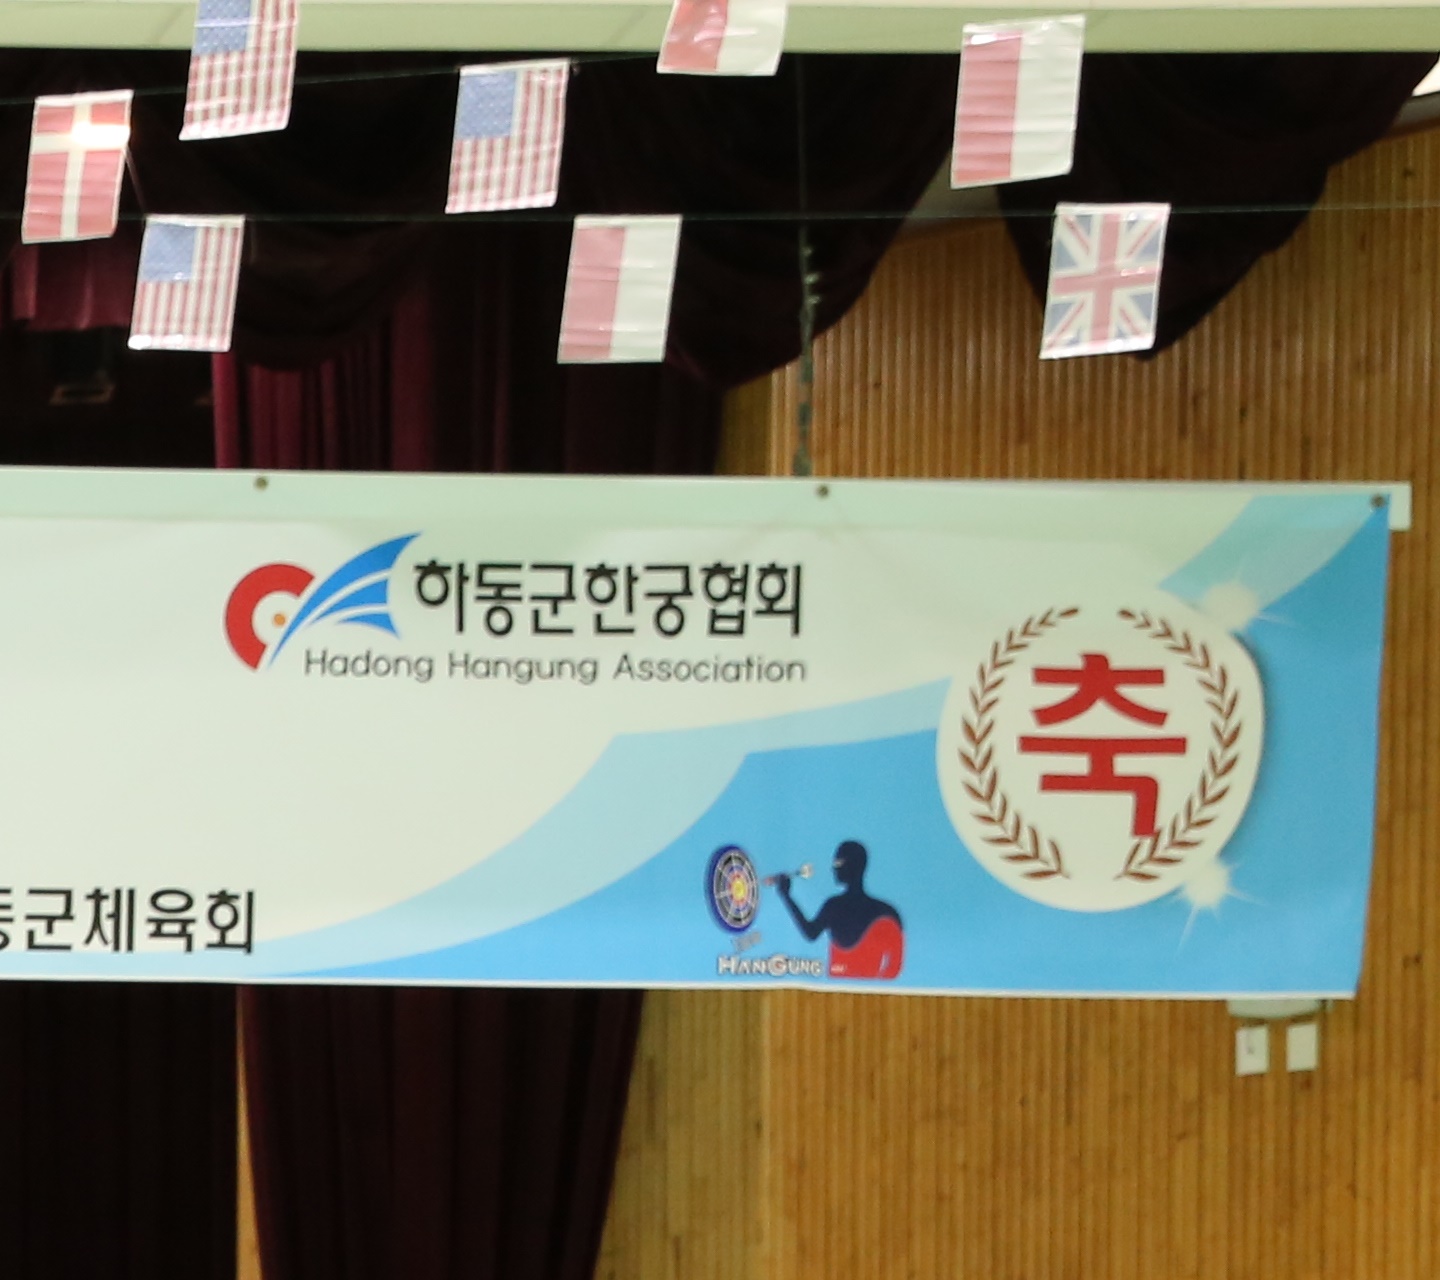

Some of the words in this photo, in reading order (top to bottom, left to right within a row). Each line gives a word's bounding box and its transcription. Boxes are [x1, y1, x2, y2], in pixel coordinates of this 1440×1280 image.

[413, 558, 802, 638] 하동군한궁협회
[305, 648, 434, 683] Hadong
[448, 652, 599, 685] Hangung
[613, 653, 807, 683] Association
[1019, 652, 1187, 837] 축
